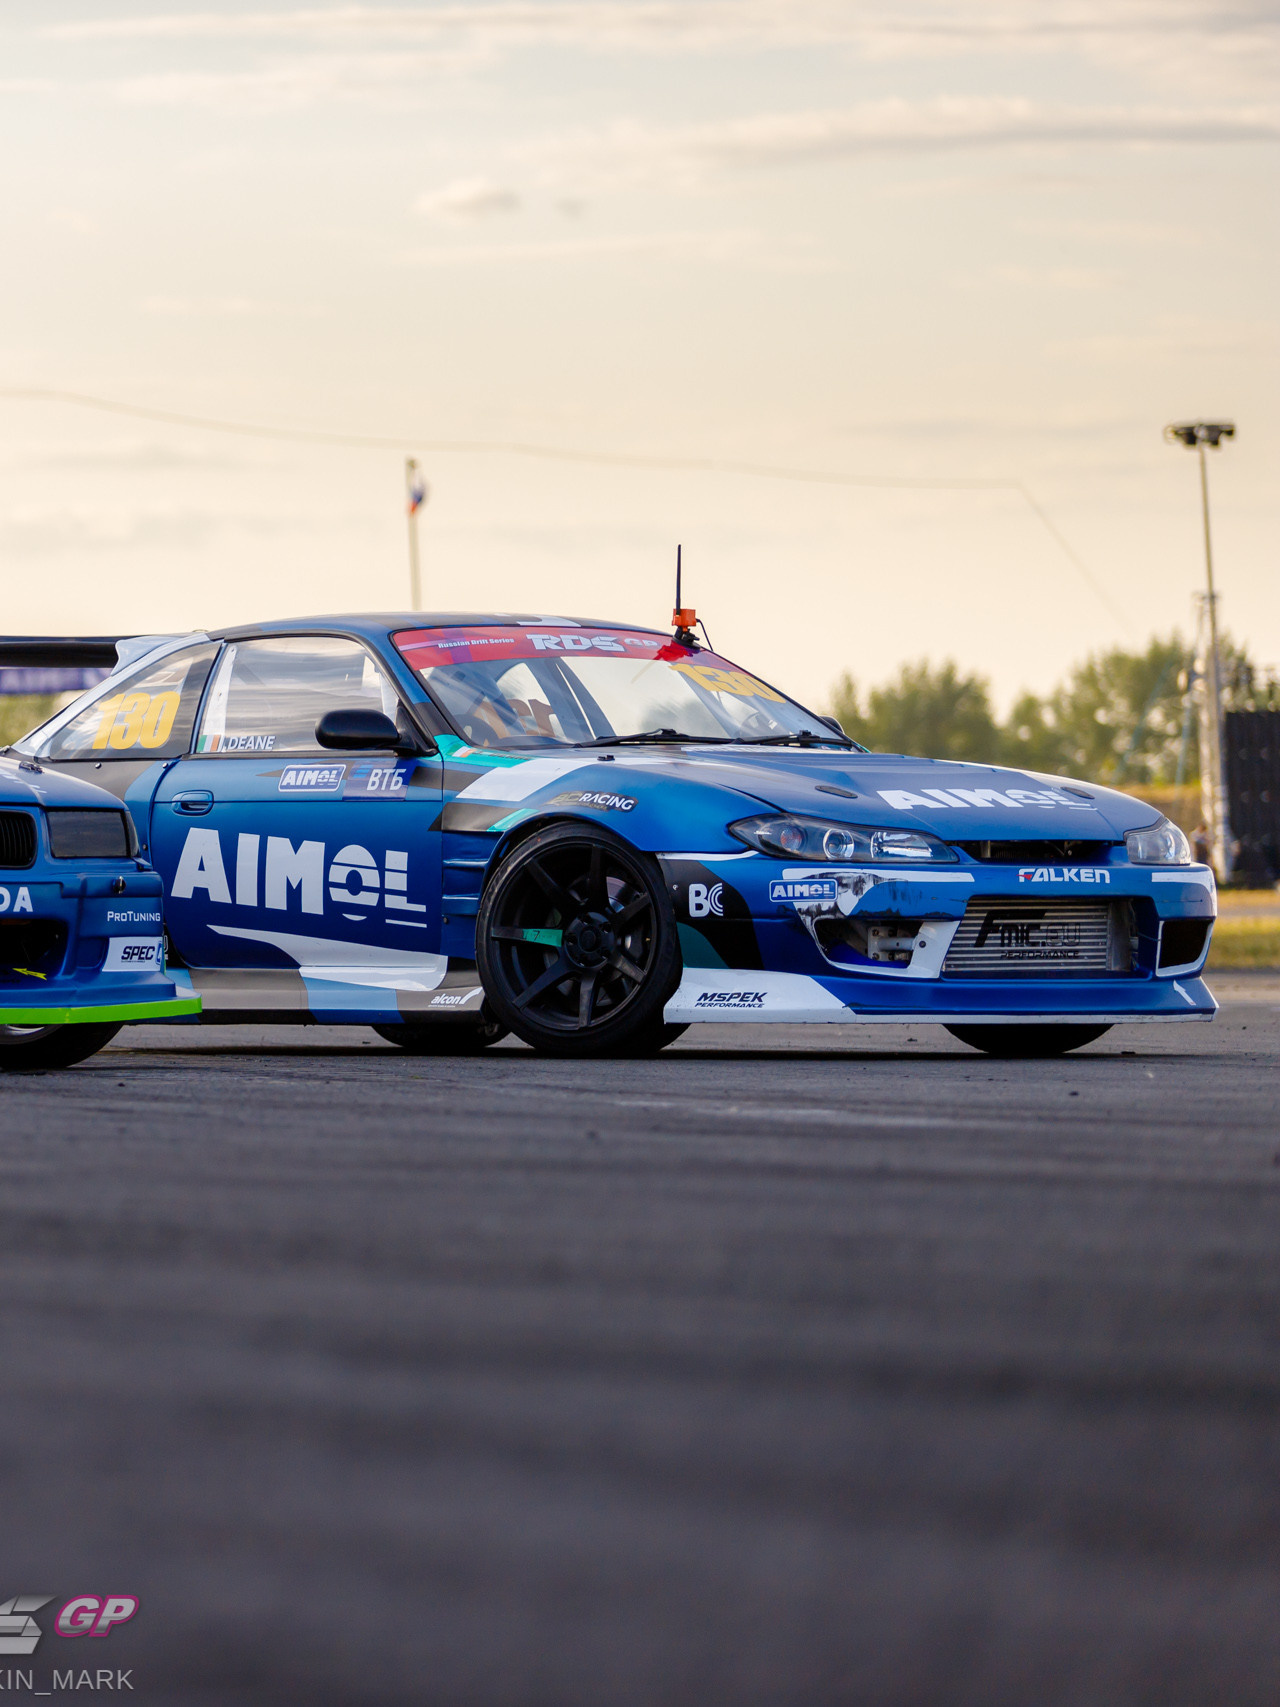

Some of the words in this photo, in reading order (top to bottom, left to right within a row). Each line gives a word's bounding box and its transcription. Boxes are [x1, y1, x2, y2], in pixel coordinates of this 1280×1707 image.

[437, 640, 470, 649] Russian
[489, 637, 515, 645] Series
[526, 633, 625, 652] RDS
[669, 663, 787, 704] 130
[92, 691, 181, 750] 130
[283, 770, 340, 788] AIMOL
[366, 768, 407, 791] ВТБ
[578, 793, 635, 811] RACING
[876, 789, 1098, 811] AIMOL
[171, 827, 427, 928] AIMOL
[1018, 868, 1111, 884] FALKEN
[772, 883, 835, 898] AIMOL
[688, 883, 724, 918] BC
[121, 945, 156, 961] SPEC
[1000, 951, 1080, 960] PERFORMANCE
[431, 993, 462, 1005] alcon
[696, 992, 768, 1003] MSPEK
